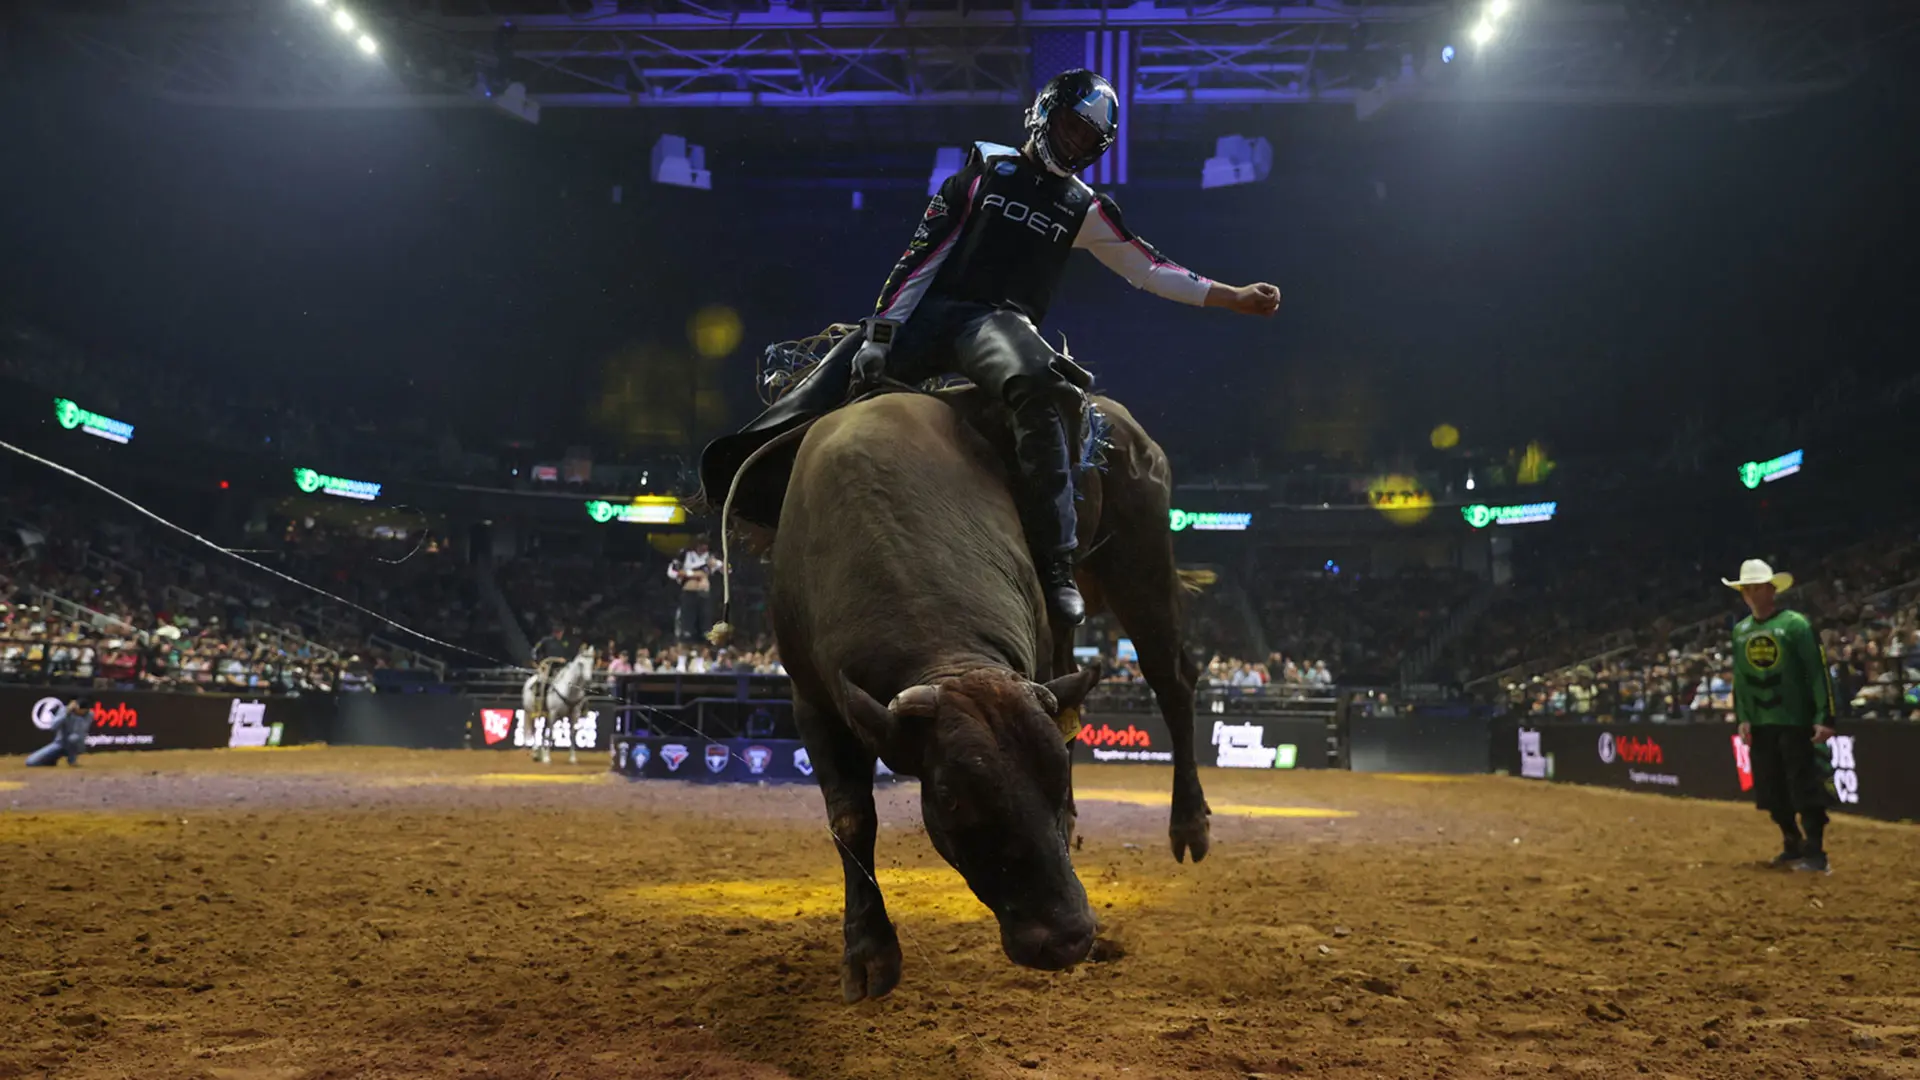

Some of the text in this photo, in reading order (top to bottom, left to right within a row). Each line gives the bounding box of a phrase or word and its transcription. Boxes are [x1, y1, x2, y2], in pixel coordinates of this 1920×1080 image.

[980, 193, 1068, 243] POET
[319, 475, 381, 496] FUNKAWAY
[1186, 512, 1252, 526] FUNKAWAY
[1489, 501, 1557, 520] FUNKAWAY
[1076, 723, 1151, 747] Kubota
